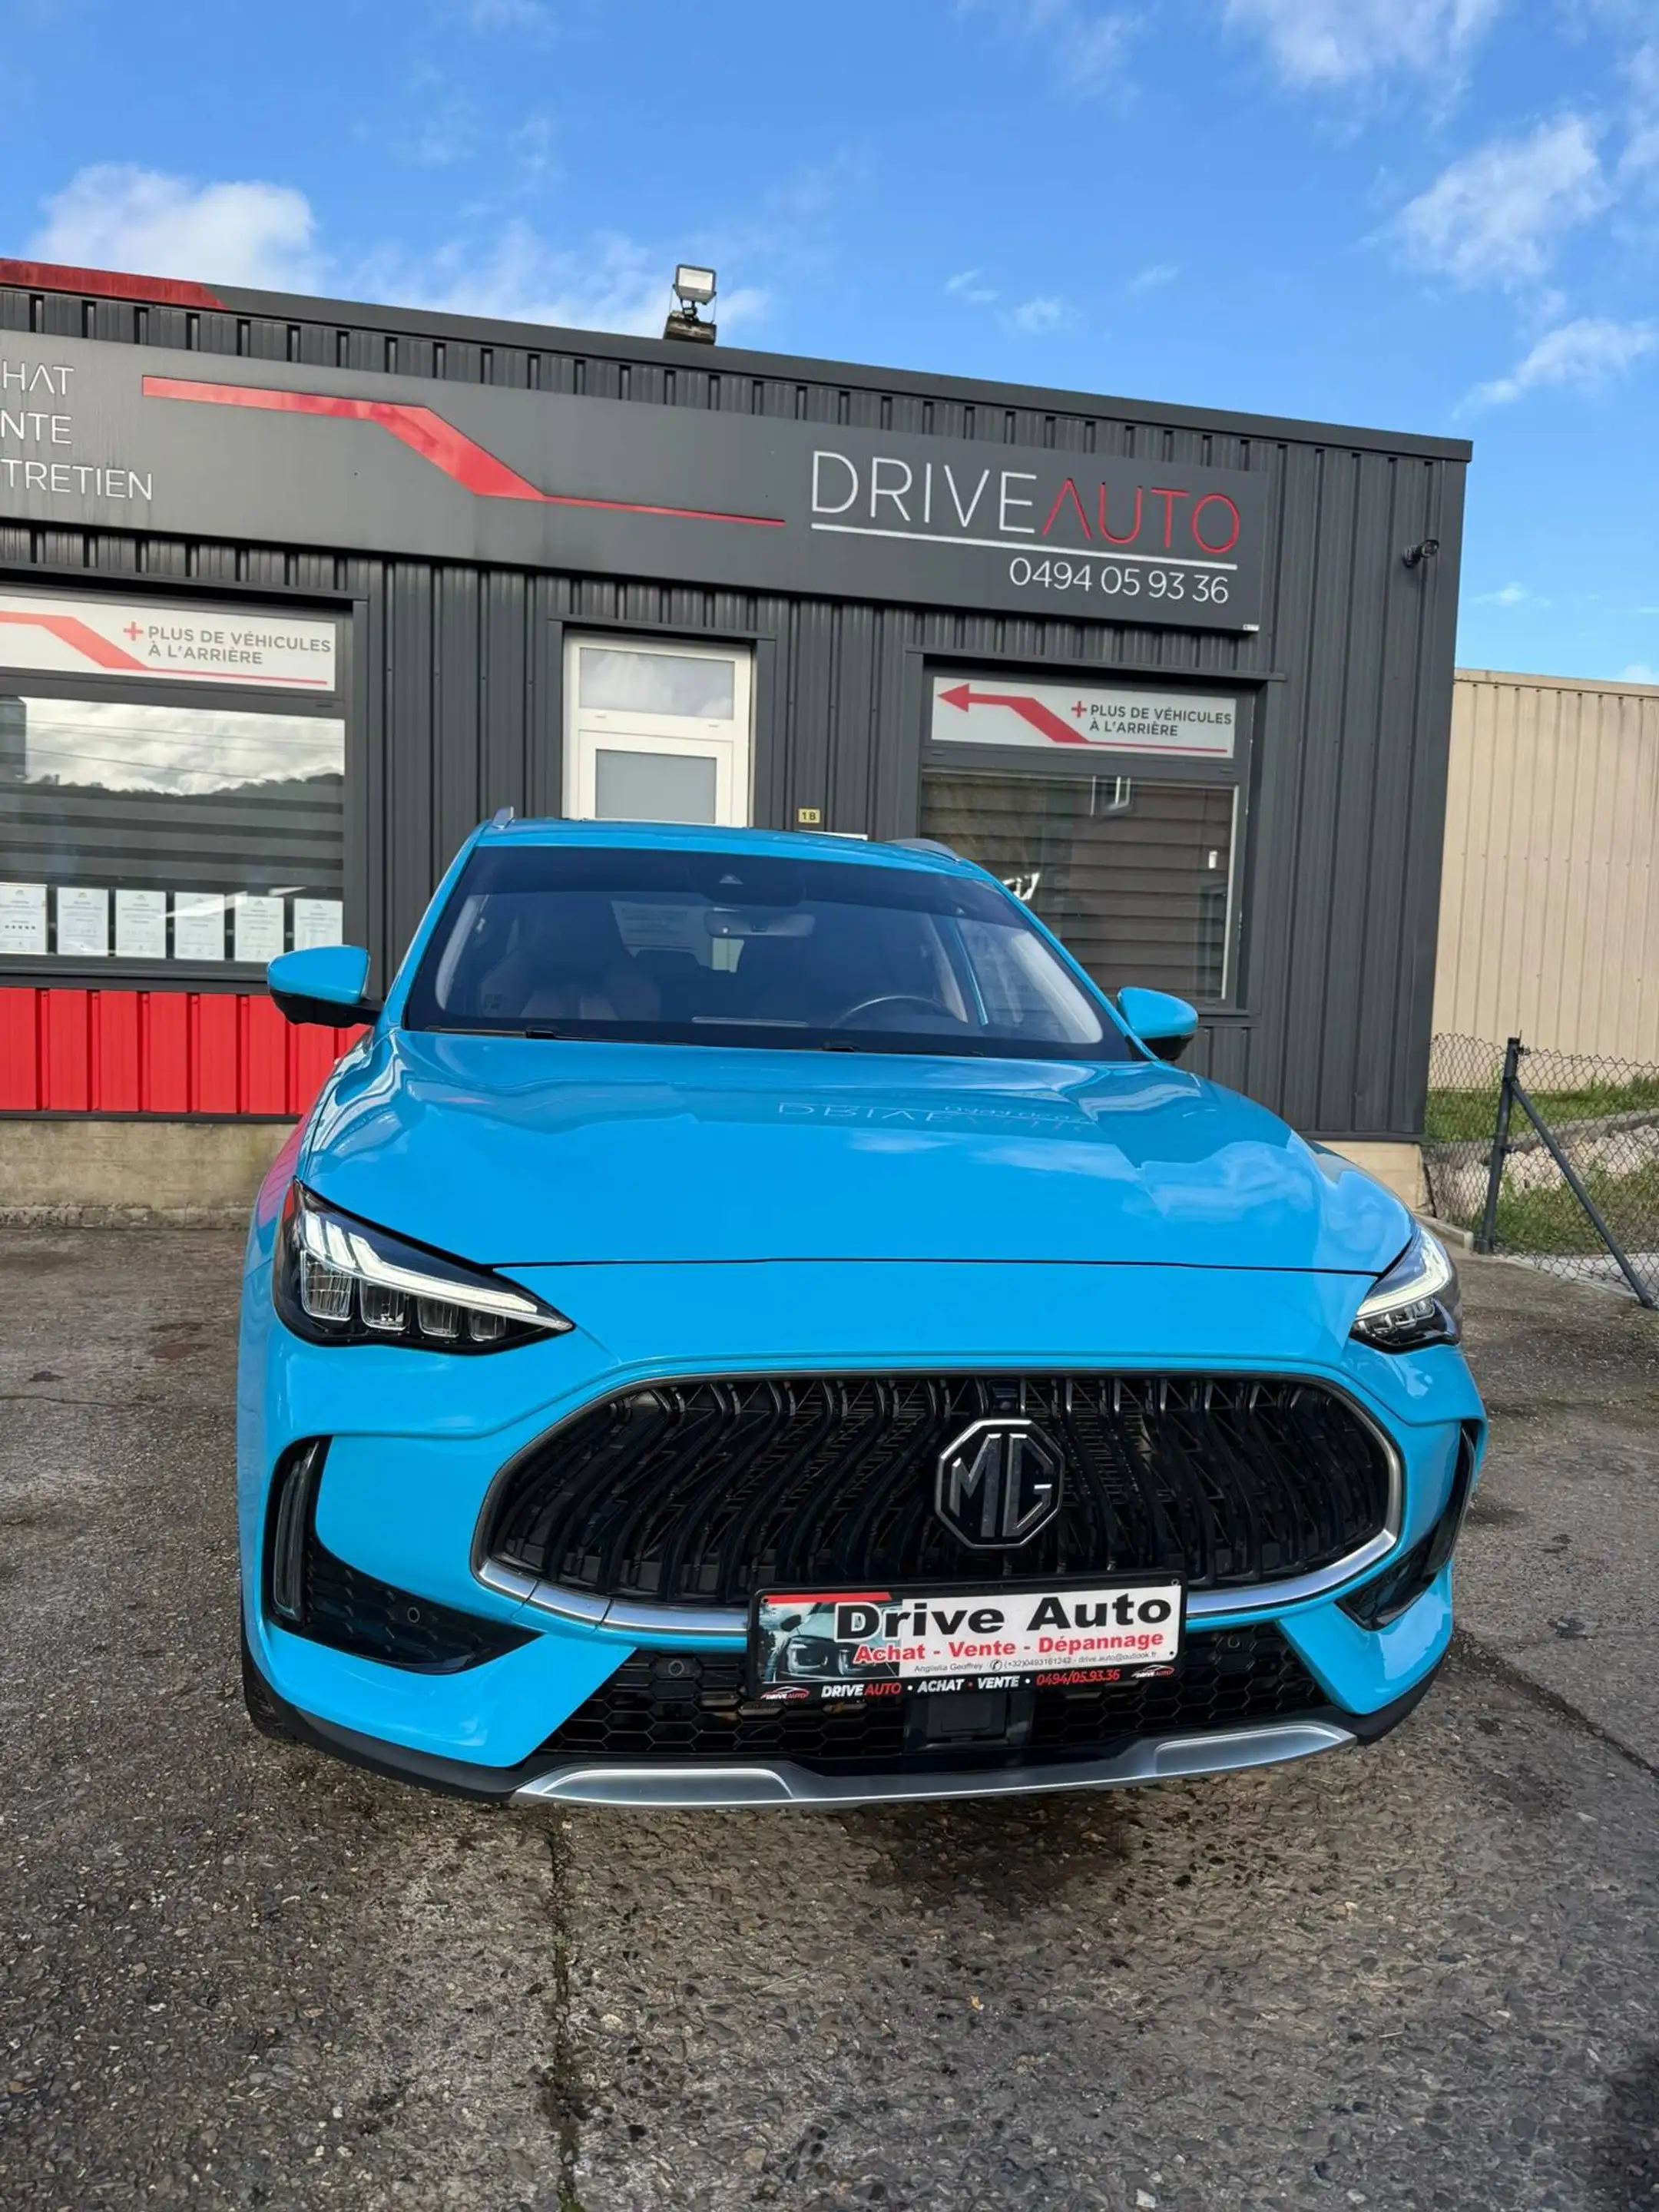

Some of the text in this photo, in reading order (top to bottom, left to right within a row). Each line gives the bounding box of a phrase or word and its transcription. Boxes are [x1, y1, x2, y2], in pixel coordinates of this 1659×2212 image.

[0, 409, 72, 445] NTE
[0, 459, 152, 501] TRETIEN
[1009, 557, 1229, 604] 0494 05 93 36
[148, 625, 332, 653] PLUS DE VÉHICULES
[148, 640, 263, 665] À L'ARRIÈRE
[1089, 717, 1178, 737] À L'ARRIÈRE
[1091, 704, 1232, 725] PLUS DE VÉHICULES
[949, 1432, 1054, 1538] MG
[835, 1593, 1172, 1641] Drive Auto
[853, 1644, 926, 1663] Achat
[948, 1641, 1016, 1658] Vente
[1038, 1633, 1164, 1654] Dépannage
[917, 1678, 965, 1693] ACHAT
[977, 1675, 1021, 1690] VENTE
